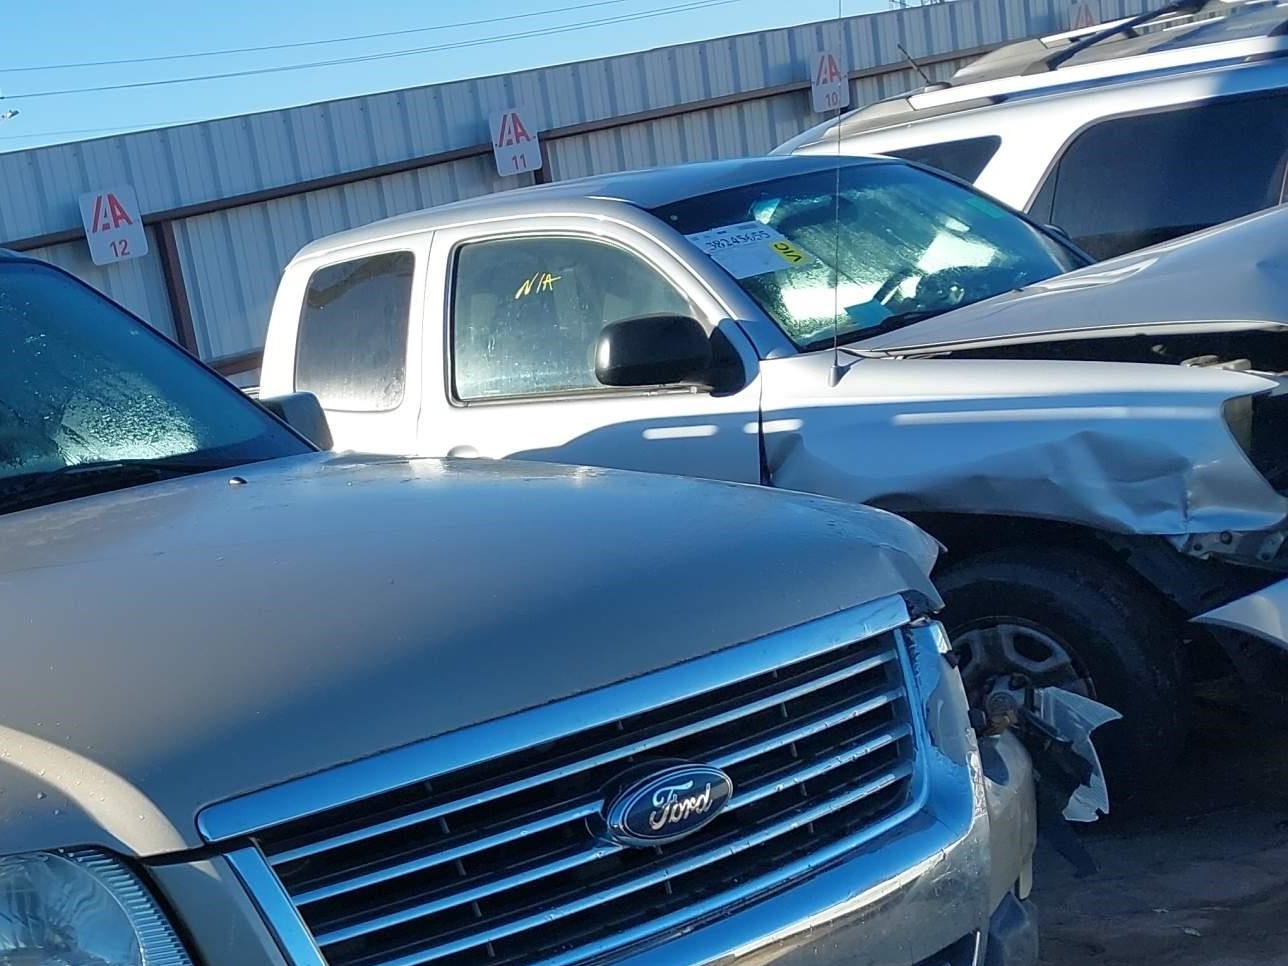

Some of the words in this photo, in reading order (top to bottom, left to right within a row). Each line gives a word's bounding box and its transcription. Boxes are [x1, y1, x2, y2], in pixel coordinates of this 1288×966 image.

[825, 92, 839, 106] 10
[512, 153, 527, 169] 11
[110, 239, 130, 257] 12
[515, 272, 562, 299] N/A
[649, 780, 712, 830] Ford
